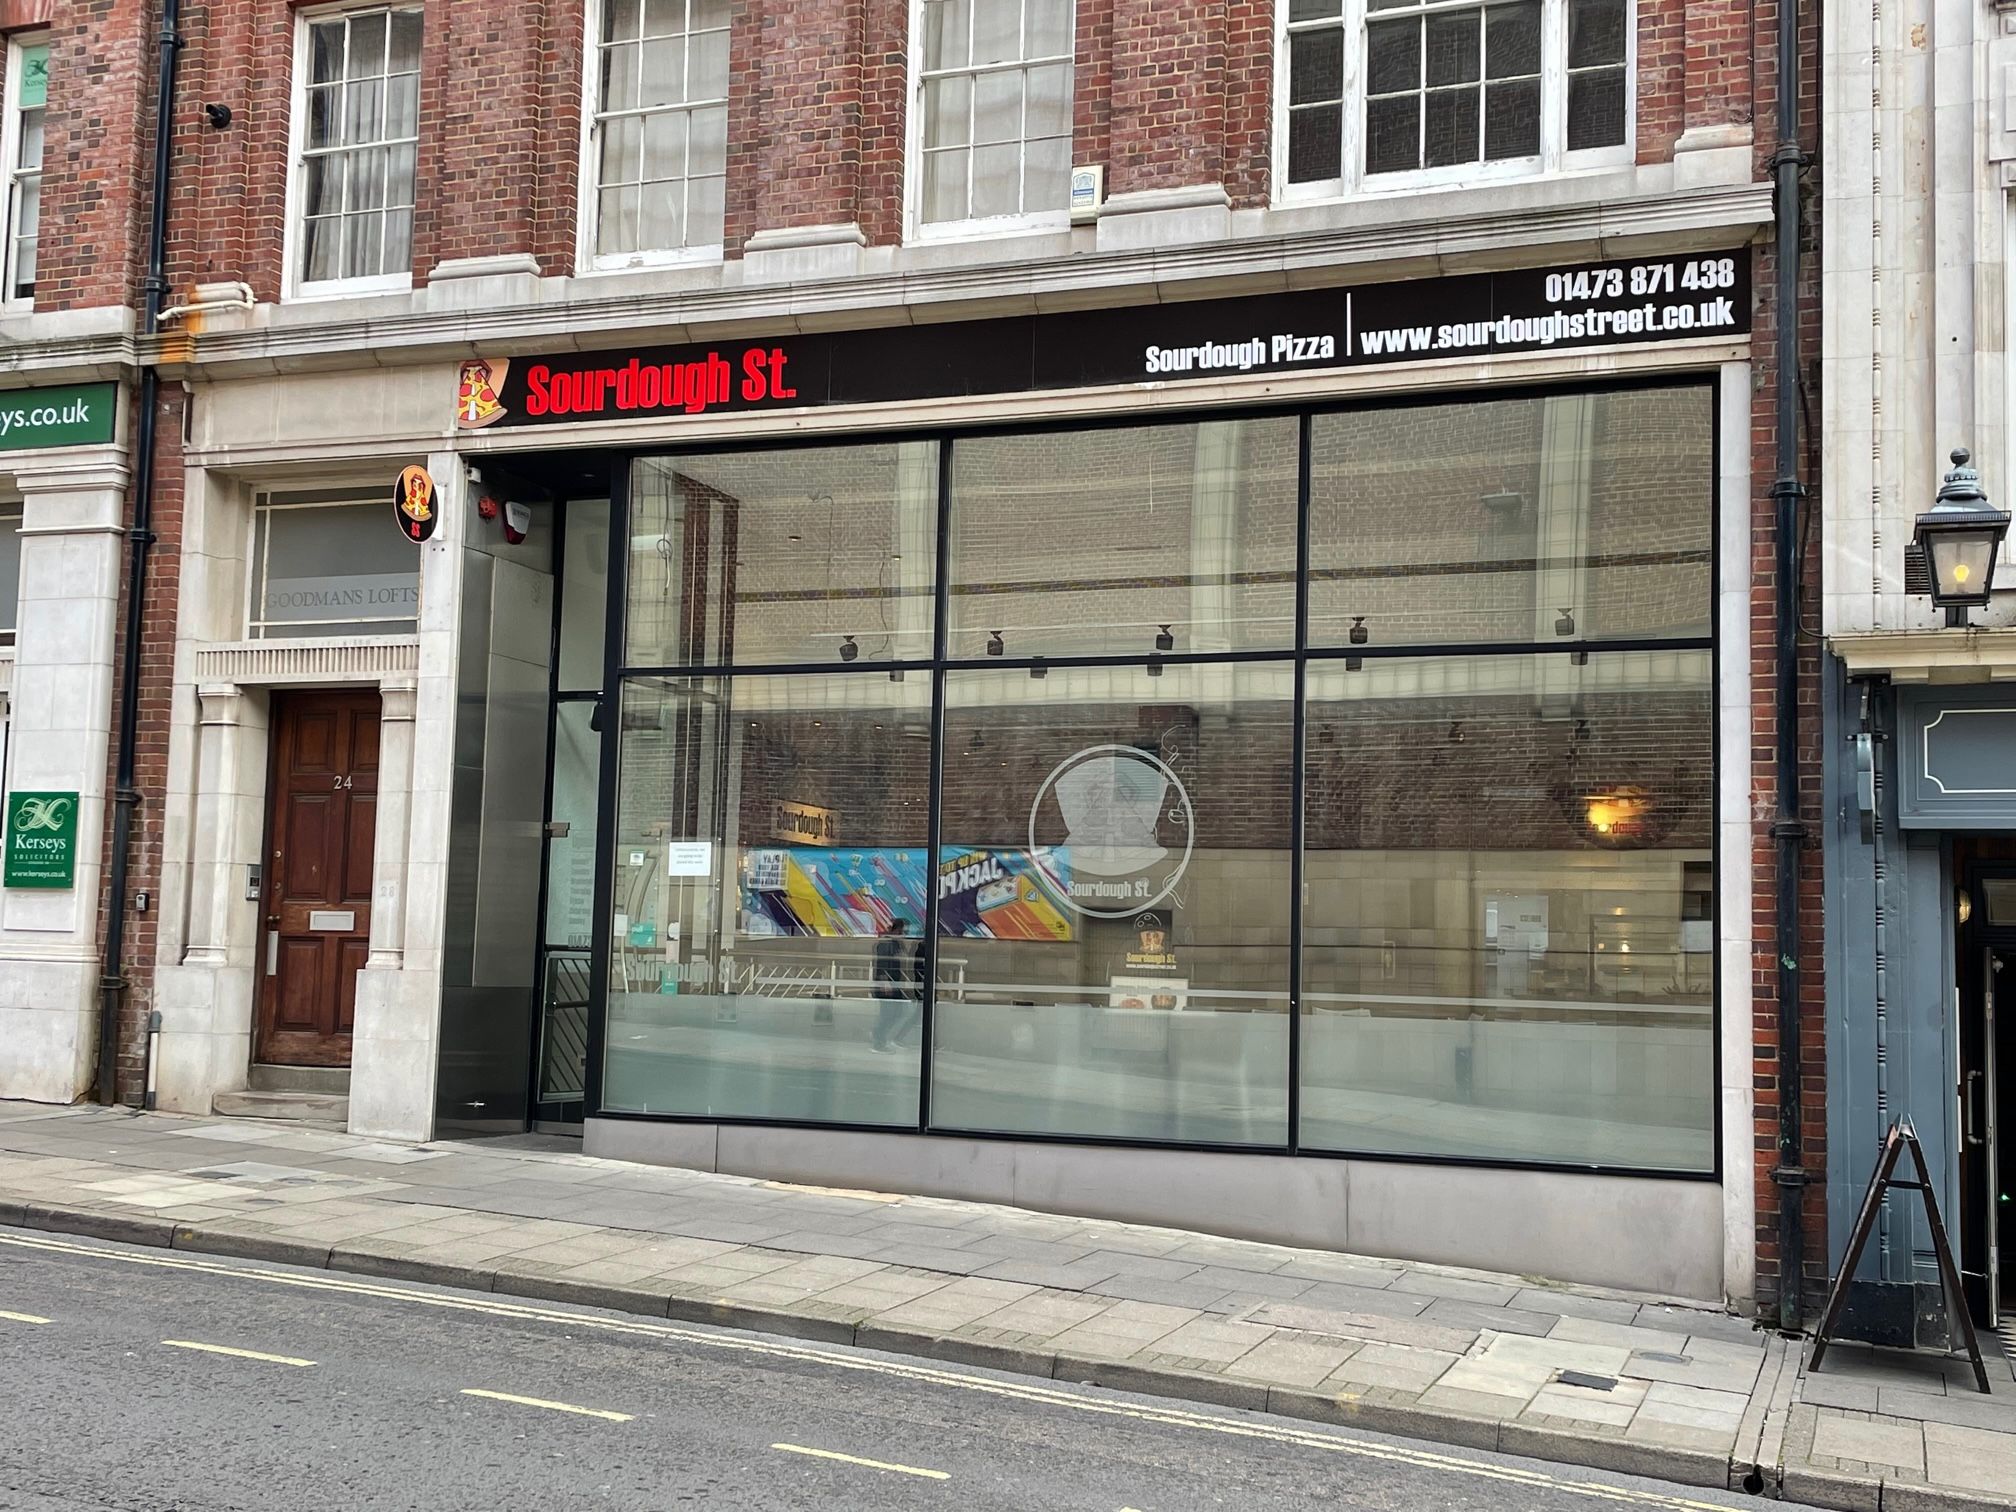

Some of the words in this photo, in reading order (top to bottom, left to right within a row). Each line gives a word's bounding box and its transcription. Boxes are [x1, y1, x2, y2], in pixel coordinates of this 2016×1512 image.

[1545, 269, 1623, 303] 01473
[1630, 263, 1676, 295] 871
[1681, 258, 1735, 290] 438
[1360, 296, 1735, 356] www.sourdoughstreet.co.uk
[1145, 342, 1266, 373] Sourdough
[1271, 334, 1335, 364] Pizza
[526, 352, 731, 416] Sourdough
[742, 348, 797, 401] St.
[0, 398, 89, 436] ys.co.uk
[268, 590, 363, 608] GOODMANS
[368, 586, 419, 604] LOFTS
[333, 775, 353, 790] 24
[777, 806, 823, 840] Sourdough
[15, 833, 66, 853] Kerseys
[14, 853, 65, 861] SOLICITORS
[11, 870, 66, 878] www.kerseys.co.uk
[1067, 880, 1132, 899] Sourdough
[1126, 951, 1166, 965] Sourdough
